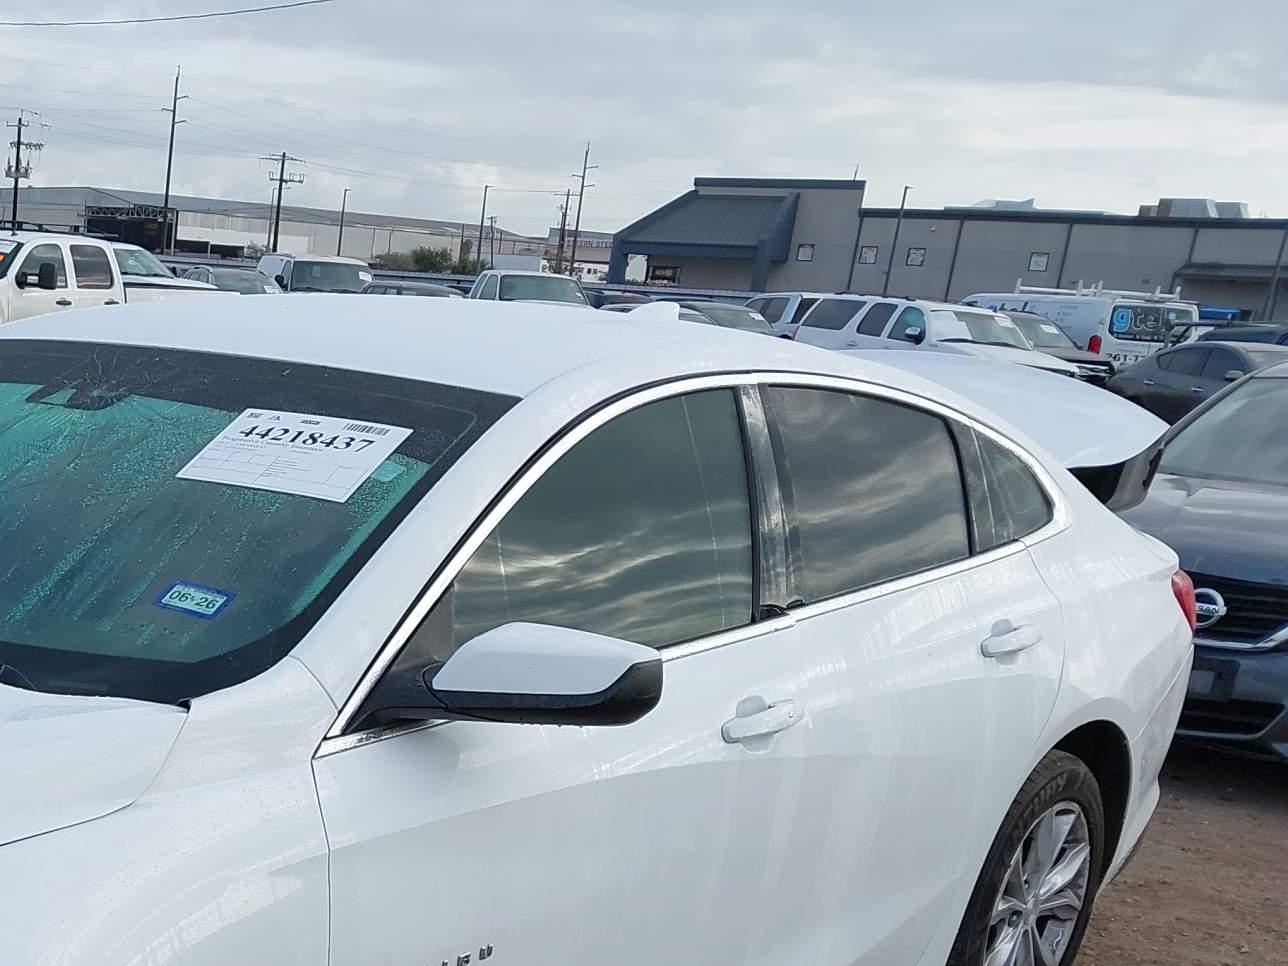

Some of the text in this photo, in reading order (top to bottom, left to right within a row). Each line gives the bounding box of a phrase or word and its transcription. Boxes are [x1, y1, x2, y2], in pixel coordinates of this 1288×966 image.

[239, 425, 376, 453] 44218437
[169, 590, 219, 609] 06 26
